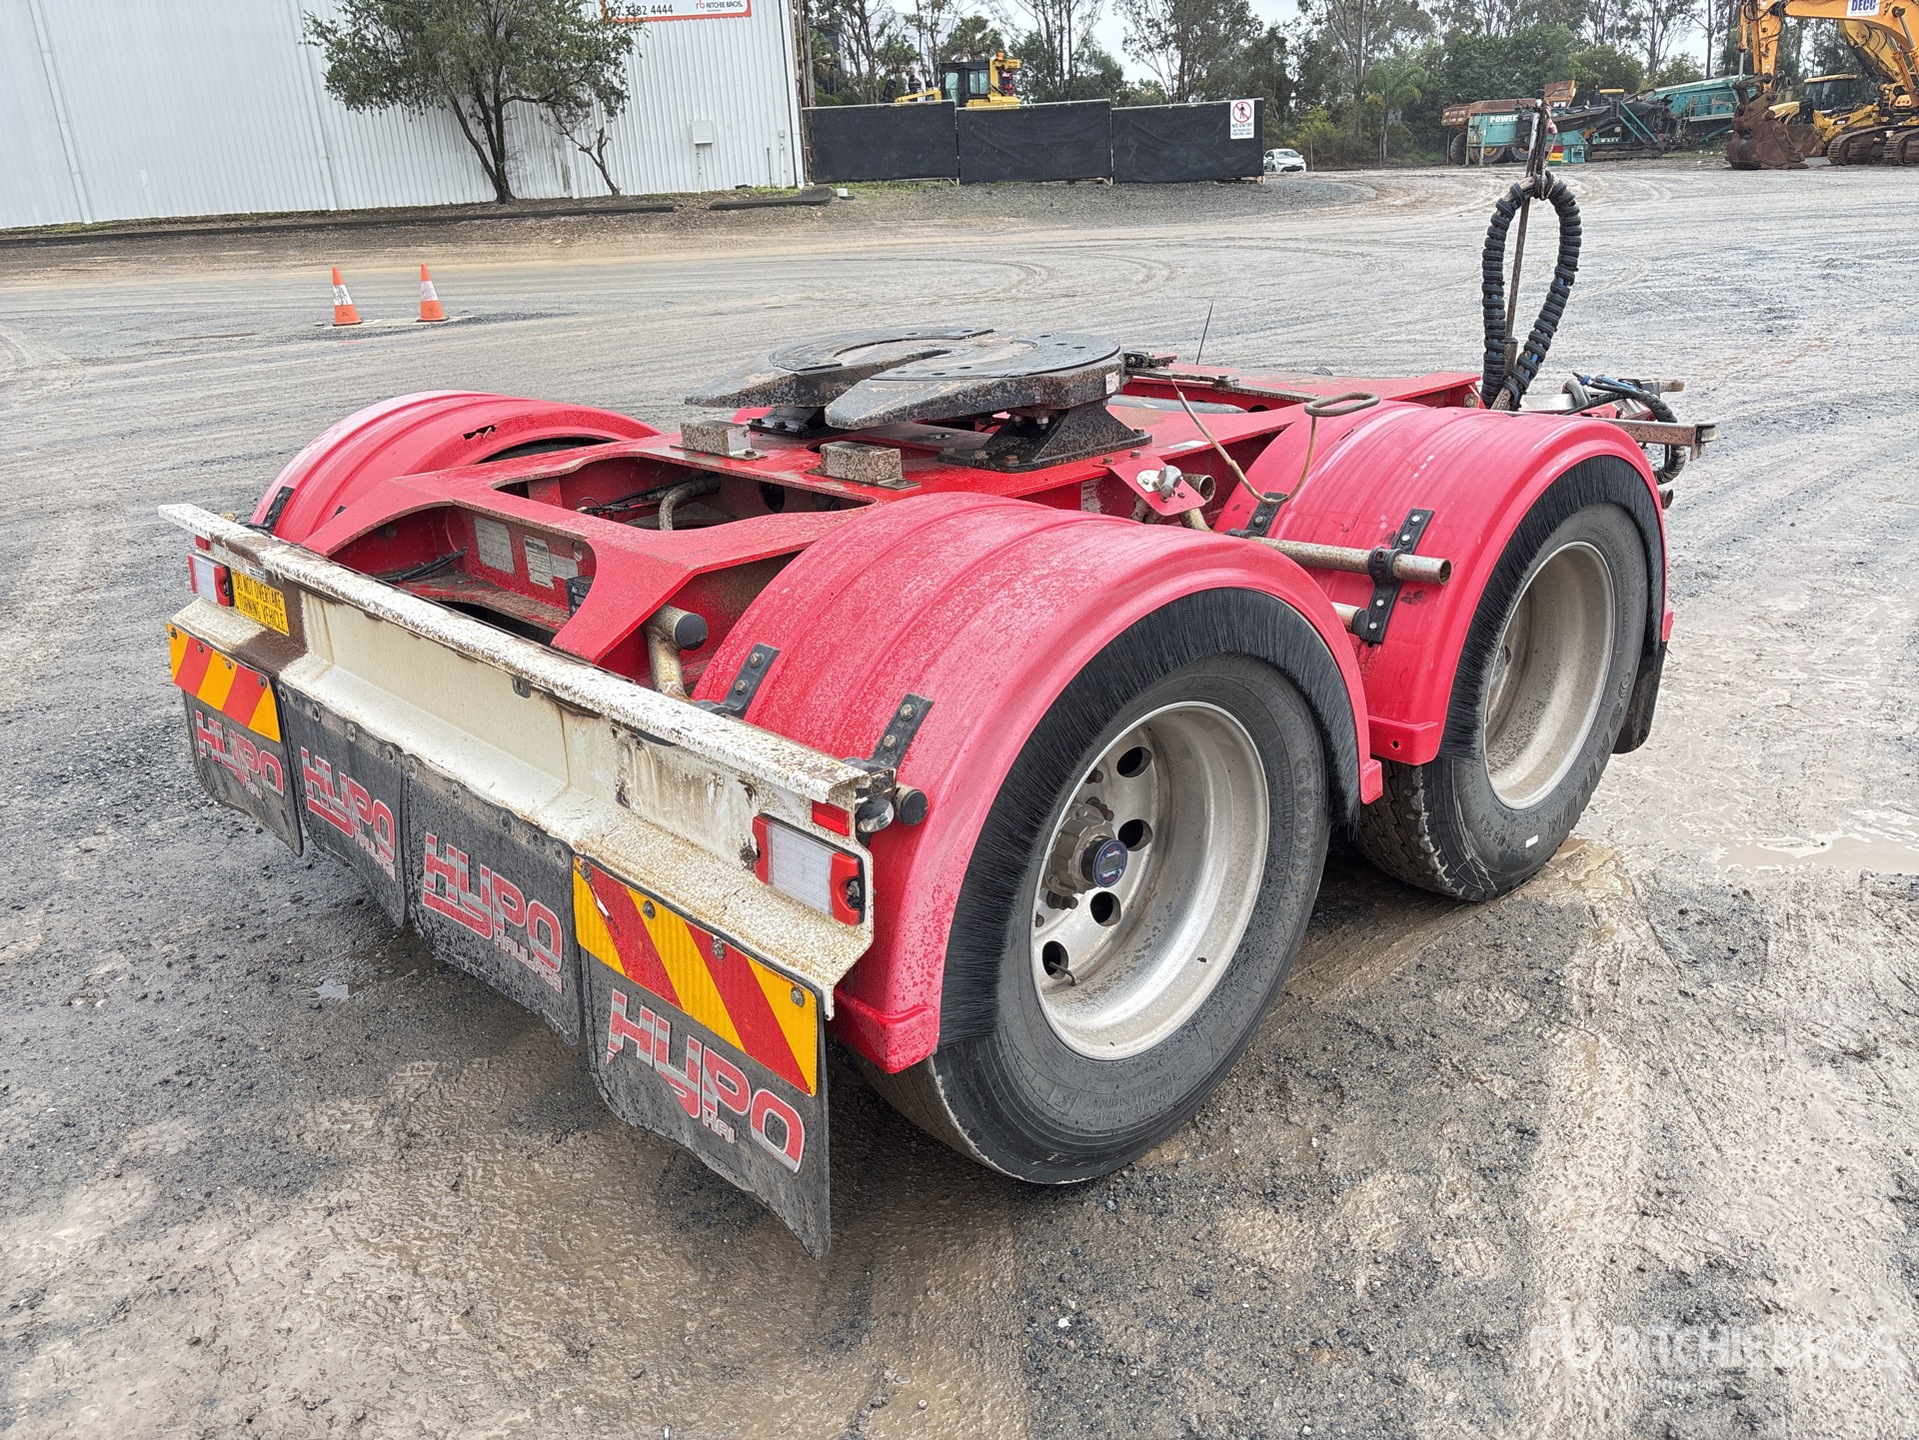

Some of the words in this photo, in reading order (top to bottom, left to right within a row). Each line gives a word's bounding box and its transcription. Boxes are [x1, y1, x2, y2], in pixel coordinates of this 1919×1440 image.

[651, 4, 673, 14] 4444
[232, 572, 243, 592] DO
[243, 576, 253, 597] NOT
[253, 580, 283, 611] OVERTAKE
[238, 592, 261, 620] TURNING
[261, 603, 287, 633] VEHICLE
[301, 746, 396, 862] HYPO
[422, 831, 563, 973] HYPO
[493, 927, 563, 995] HAULAGE
[606, 988, 806, 1174] HYPO
